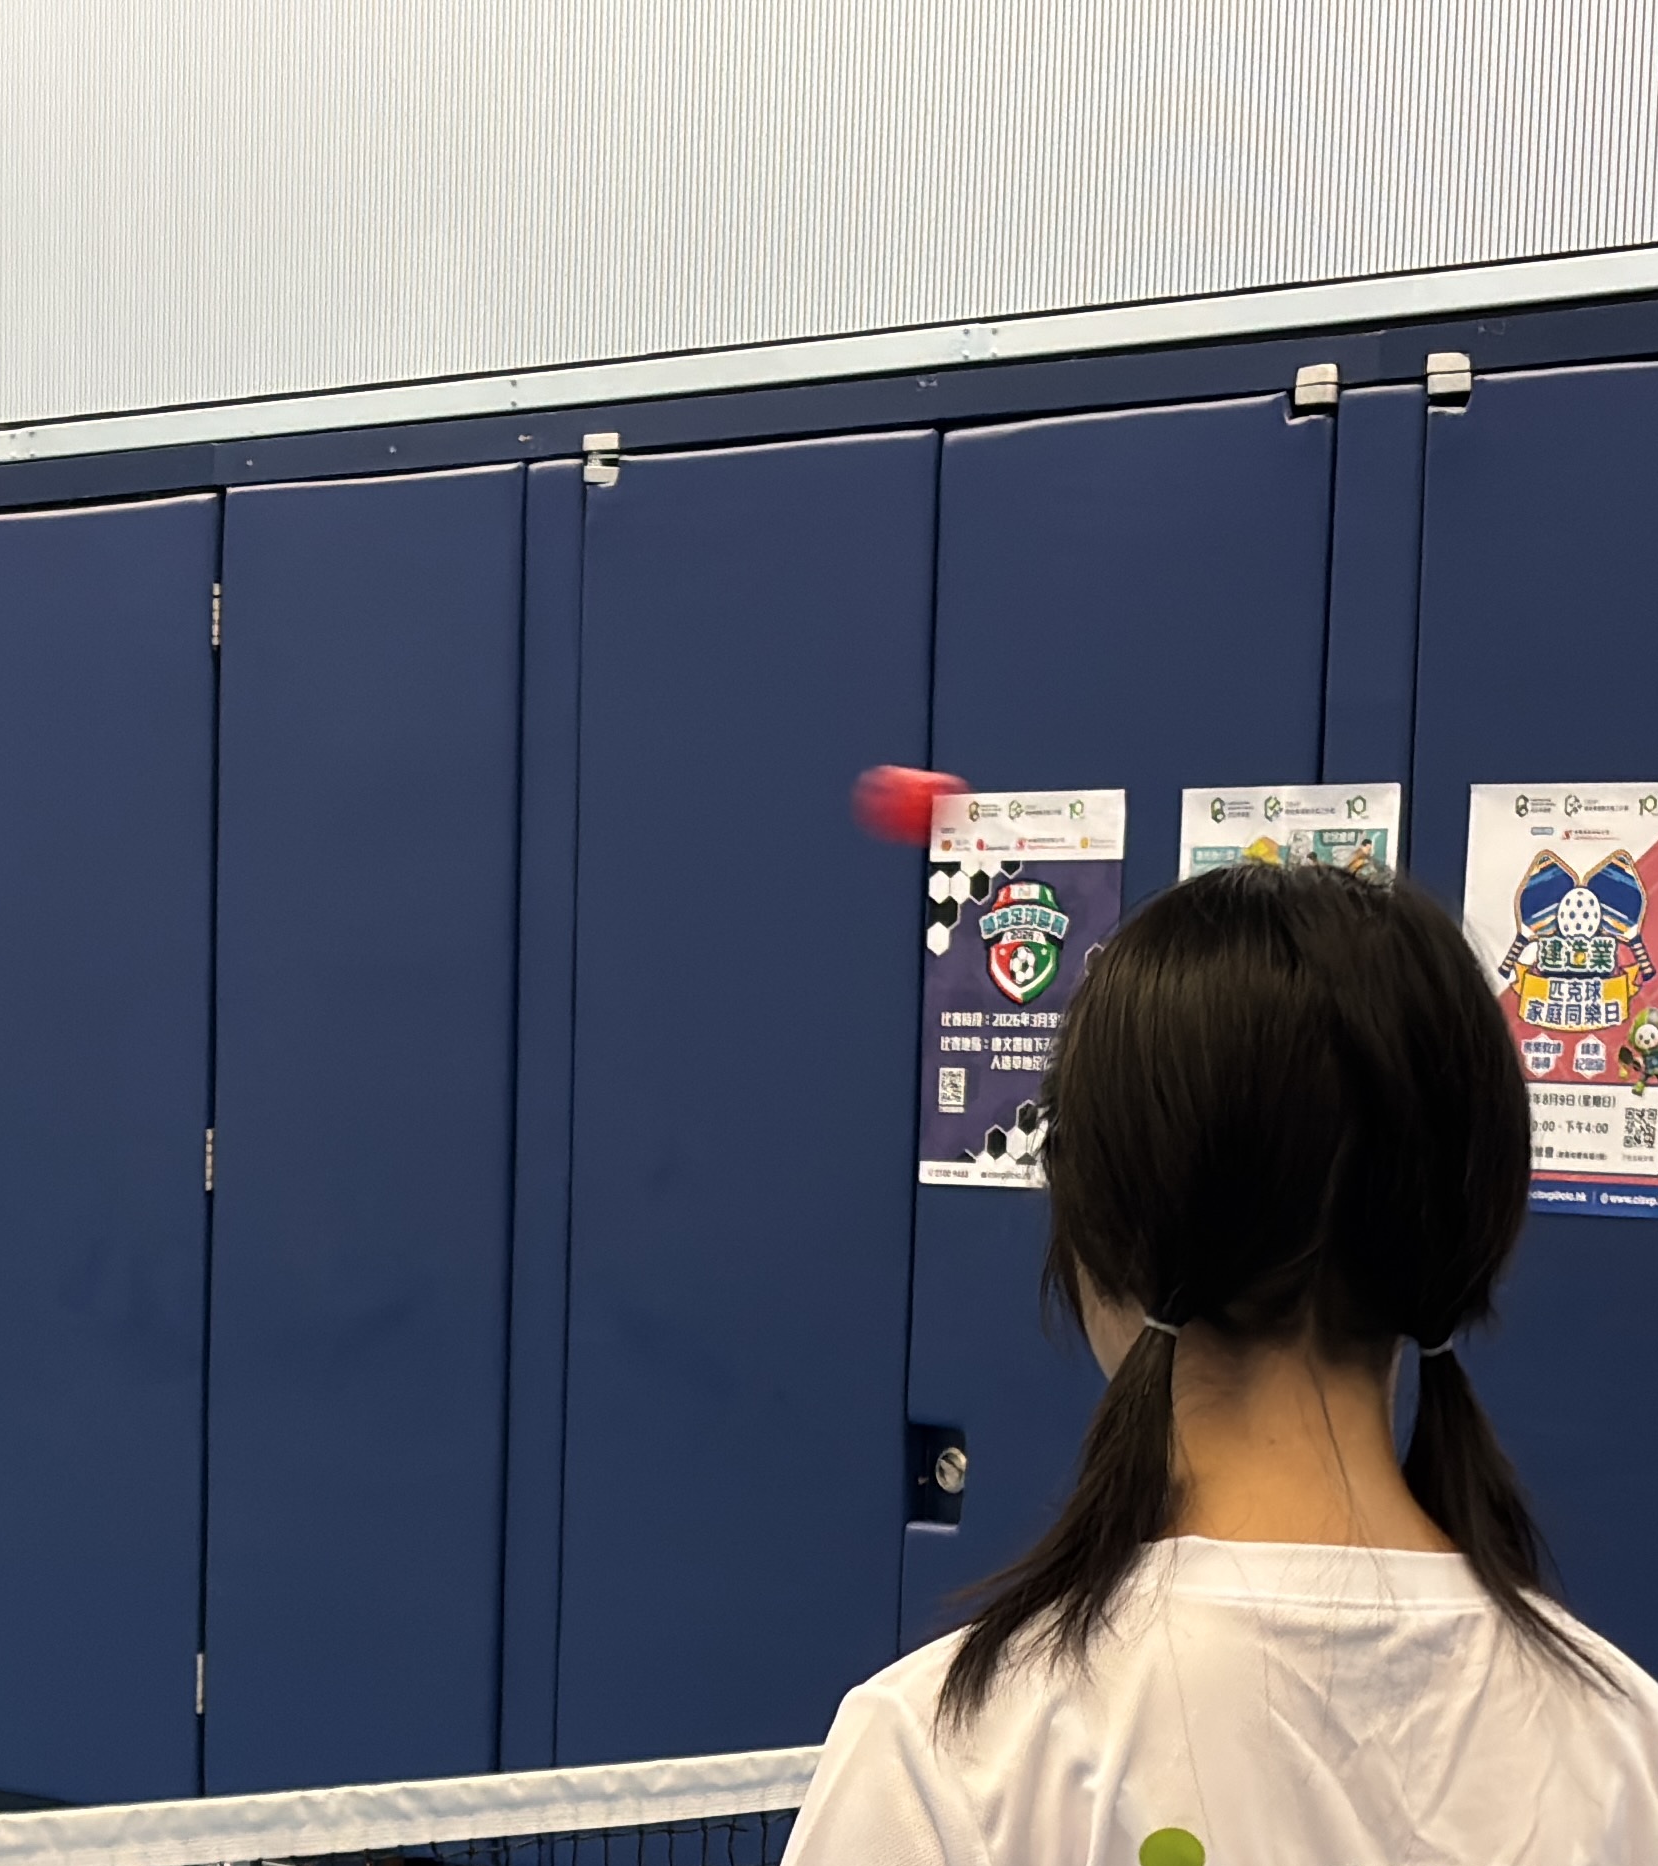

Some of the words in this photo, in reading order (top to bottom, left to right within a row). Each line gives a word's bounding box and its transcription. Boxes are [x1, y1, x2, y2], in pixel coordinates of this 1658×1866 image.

[1540, 938, 1615, 971] 建造業
[1549, 979, 1602, 1002] 匹克球
[1526, 1000, 1621, 1026] 家庭同樂日
[1530, 1093, 1616, 1108] 年8月9日(星期日)
